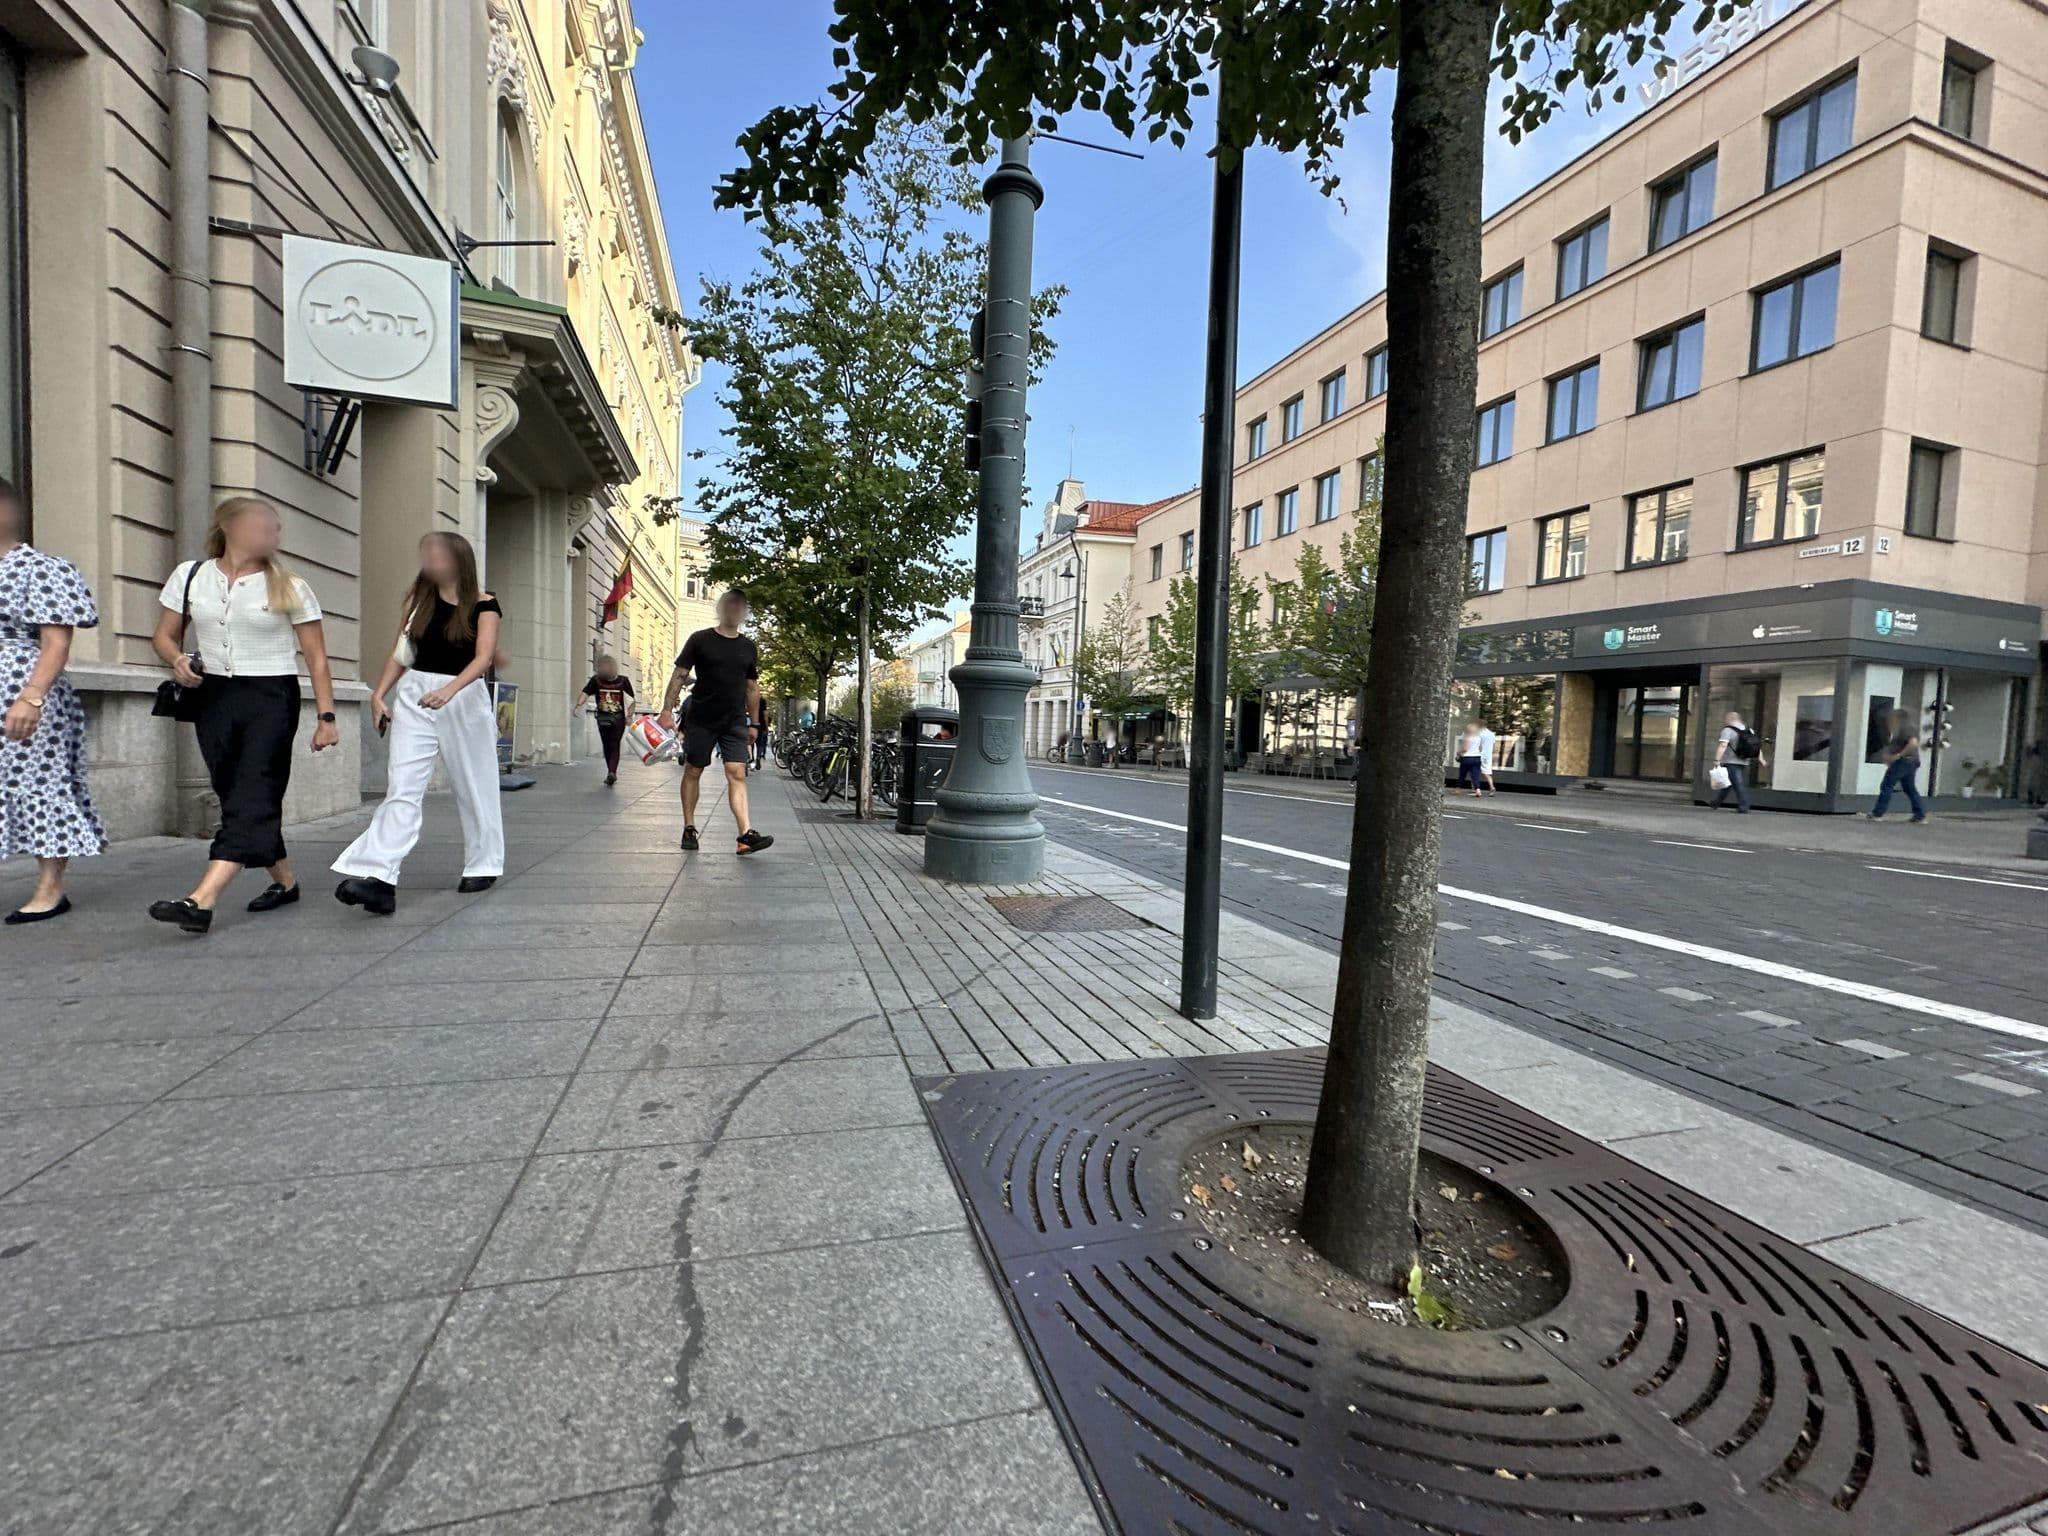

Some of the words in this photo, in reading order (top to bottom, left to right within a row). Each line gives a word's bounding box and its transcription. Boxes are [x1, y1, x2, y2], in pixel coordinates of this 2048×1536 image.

[1845, 539, 1860, 553] 12
[1880, 538, 1889, 551] 12
[1628, 624, 1658, 634] Smart
[1627, 633, 1661, 642] Master
